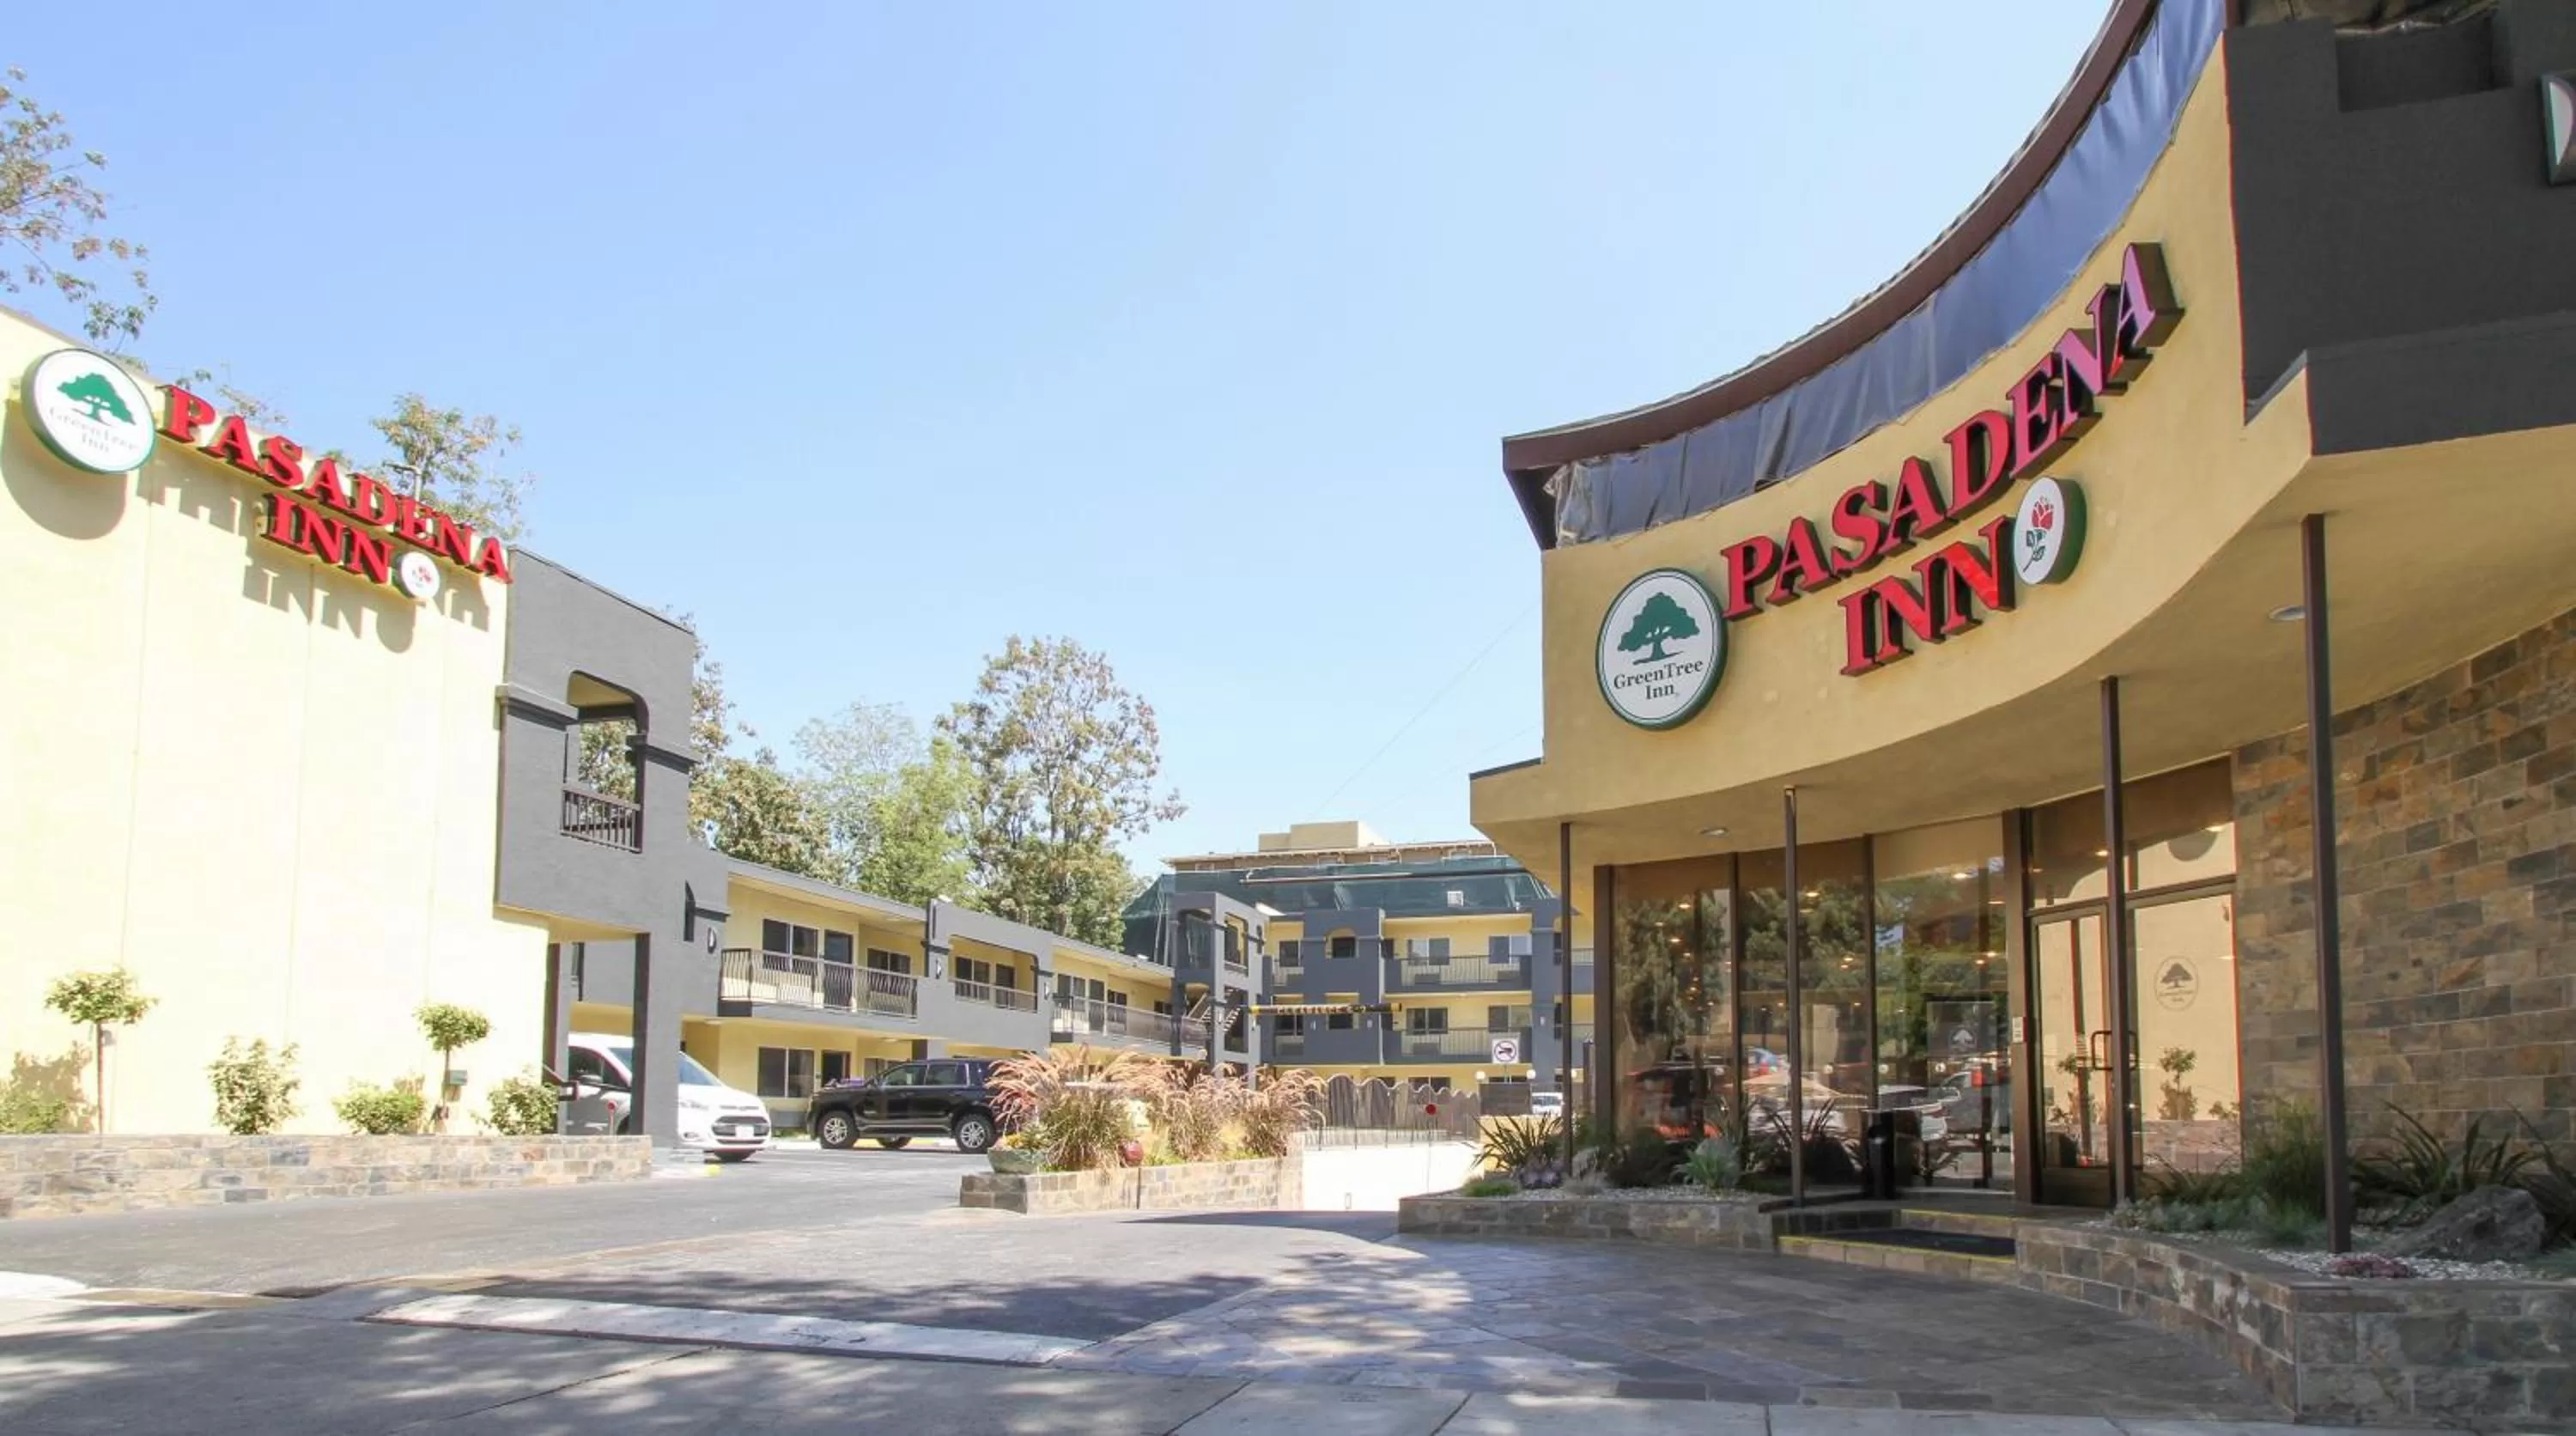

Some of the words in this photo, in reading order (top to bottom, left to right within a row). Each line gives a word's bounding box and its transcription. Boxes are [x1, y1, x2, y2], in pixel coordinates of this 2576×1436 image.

[160, 384, 513, 584] PASADENA
[1721, 243, 2159, 618] PASADENA
[260, 492, 396, 585] INN
[1837, 514, 2009, 677] INN
[1613, 659, 1704, 690] GreenTree
[1644, 684, 1675, 700] Inn
